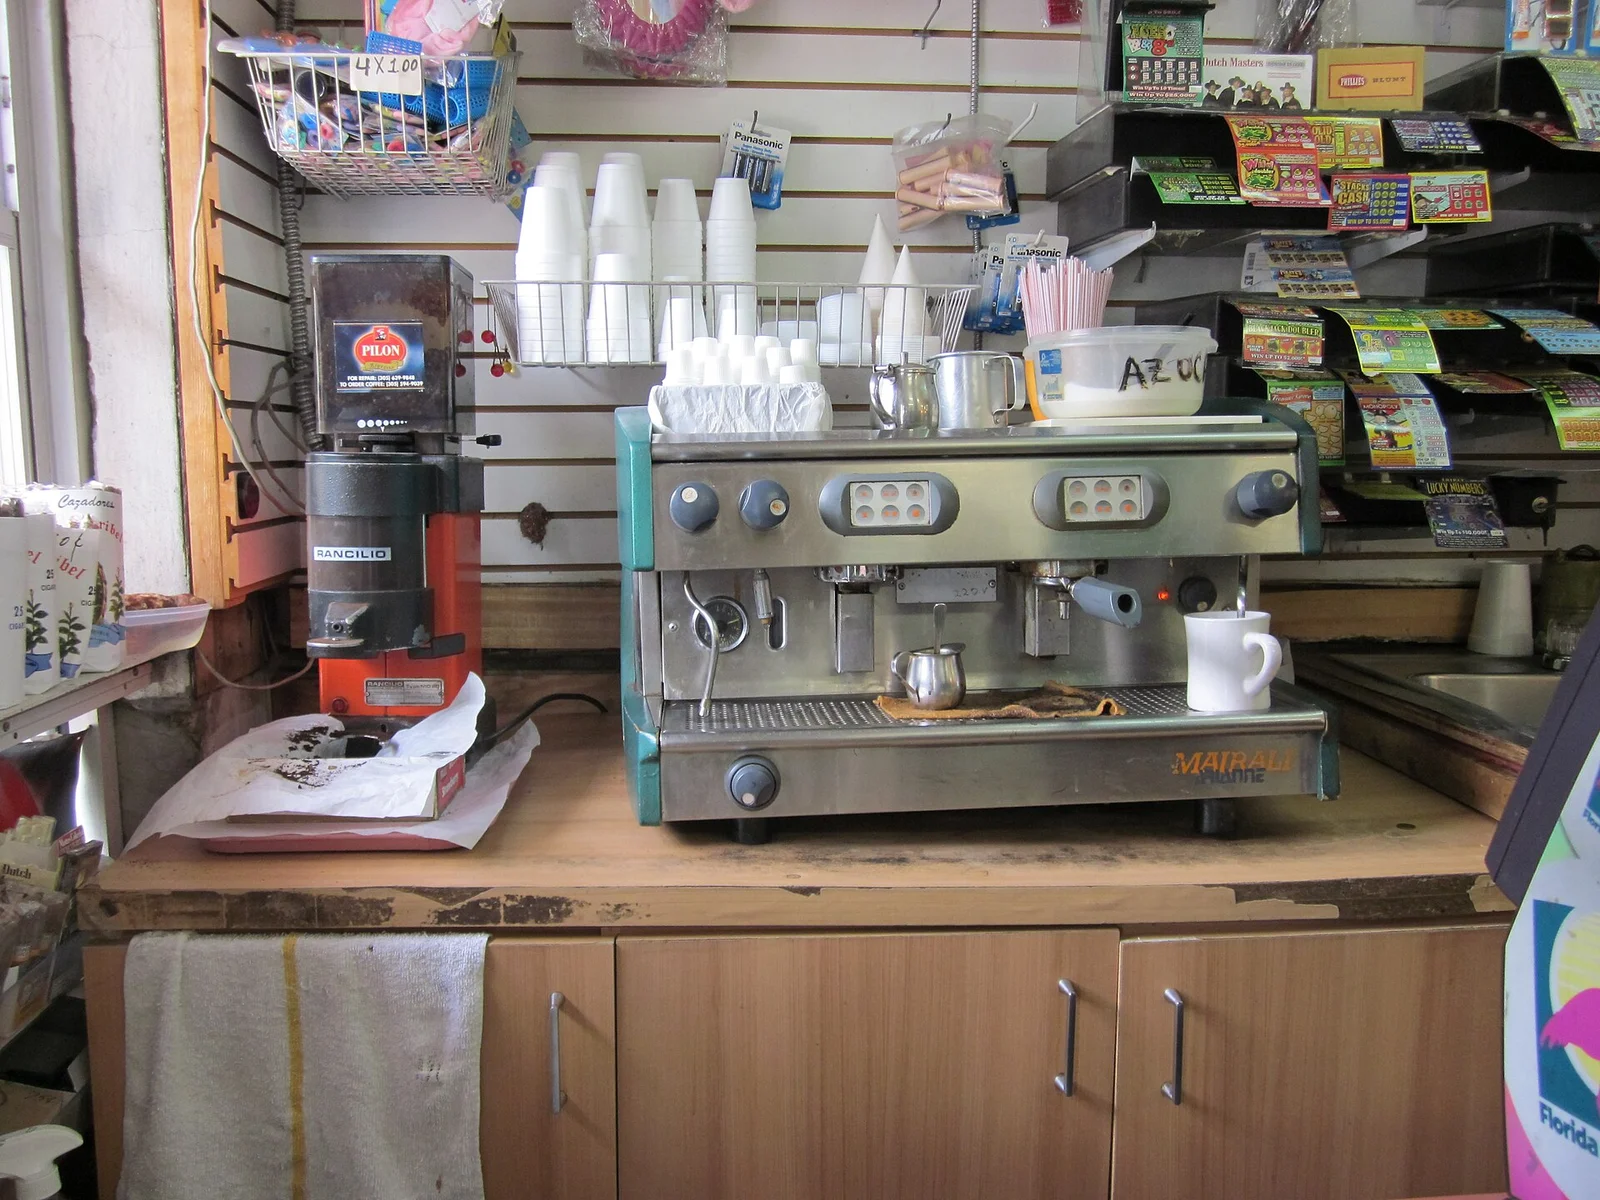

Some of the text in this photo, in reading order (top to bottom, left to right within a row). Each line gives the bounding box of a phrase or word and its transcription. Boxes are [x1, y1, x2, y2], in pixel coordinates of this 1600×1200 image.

[355, 57, 370, 76] 4
[1230, 57, 1264, 67] Masters
[1340, 77, 1365, 86] PHILLIES
[734, 131, 783, 150] Panasonic
[1340, 181, 1370, 191] STACKS
[1337, 191, 1370, 205] CASH
[361, 344, 400, 357] PILON
[1426, 482, 1485, 495] LUCKY NUMBERS
[58, 494, 115, 510] Cazadores
[316, 549, 387, 559] RANCILIO
[13, 606, 24, 617] 25
[2, 863, 32, 880] Dutch
[1539, 1101, 1599, 1158] Florida
